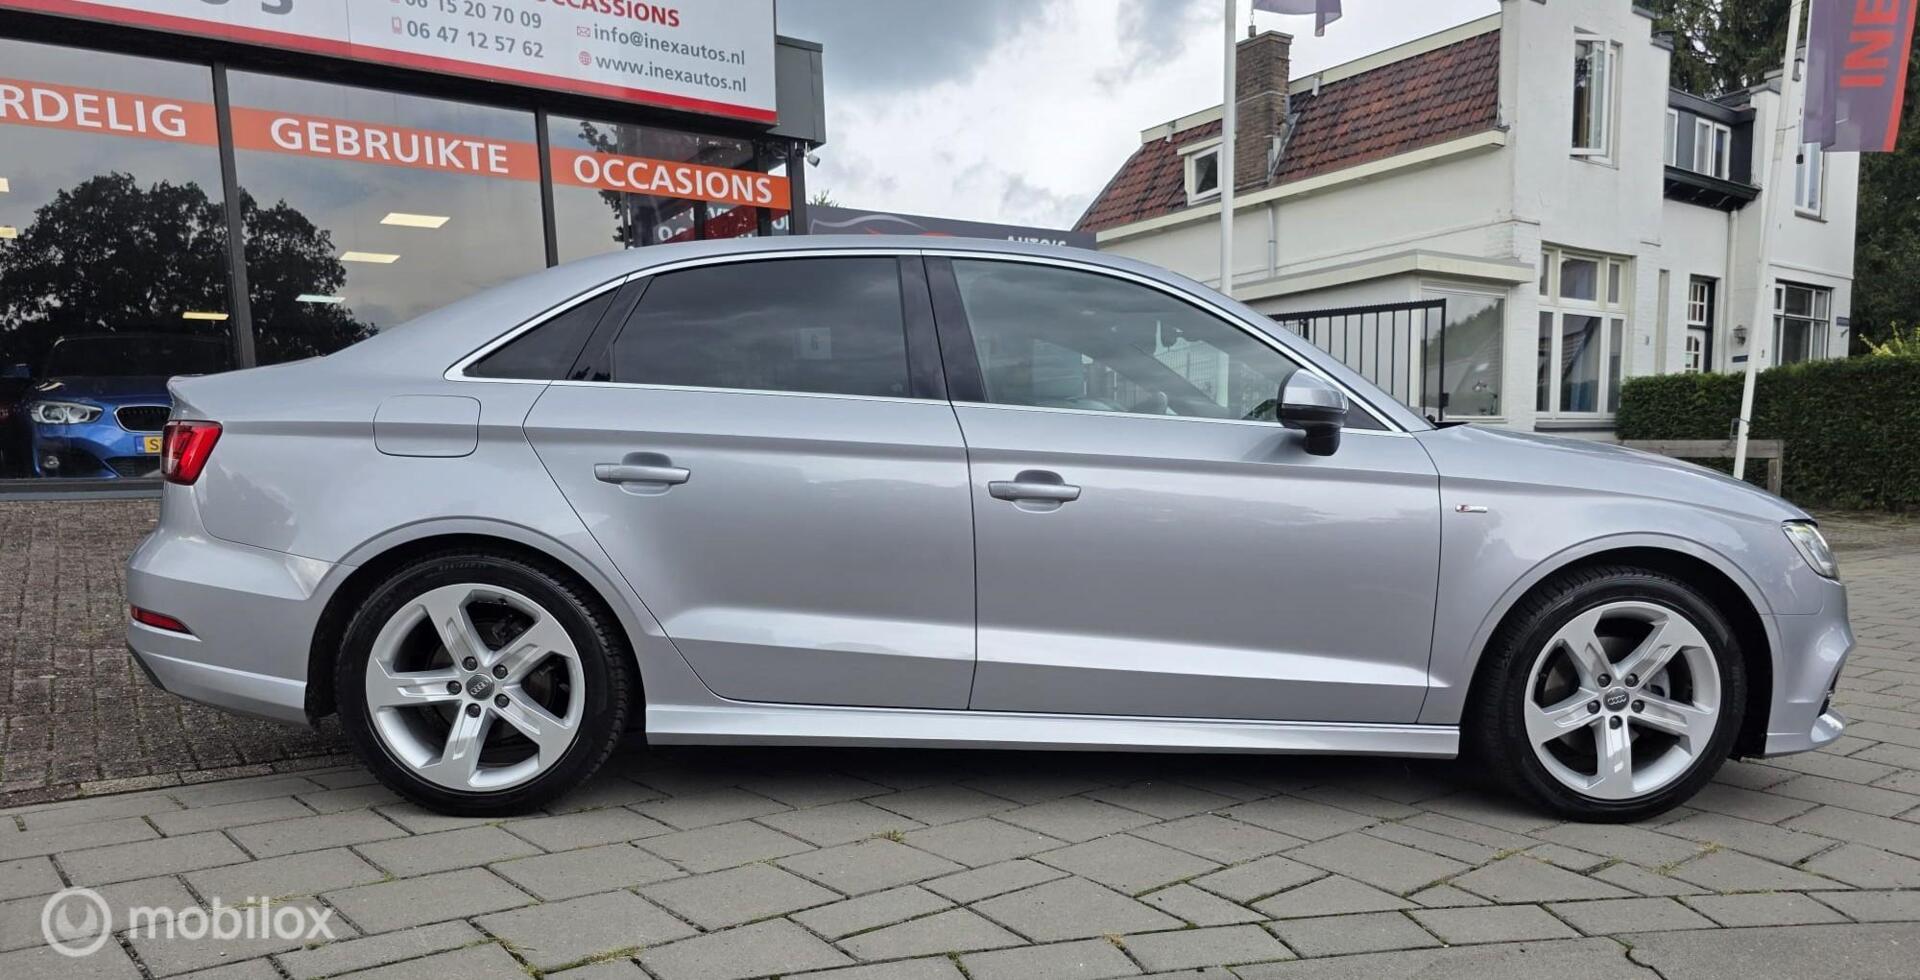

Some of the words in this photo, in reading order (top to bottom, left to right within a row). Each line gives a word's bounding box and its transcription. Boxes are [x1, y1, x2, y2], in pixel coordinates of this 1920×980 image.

[438, 0, 457, 14] 15
[463, 1, 486, 19] 20
[492, 5, 514, 24] 70
[520, 11, 542, 29] 09
[536, 0, 681, 28] CASSIONS
[406, 20, 431, 39] 06
[436, 26, 459, 44] 47
[467, 31, 489, 50] 12
[494, 36, 516, 54] 57
[522, 40, 544, 58] 62
[594, 24, 745, 65] info@inexautos.nl
[595, 56, 747, 92] www.inexautos.nl
[0, 83, 187, 138] RDELIG
[270, 117, 510, 174] GEBRUIKTE
[573, 155, 773, 204] OCCASIONS
